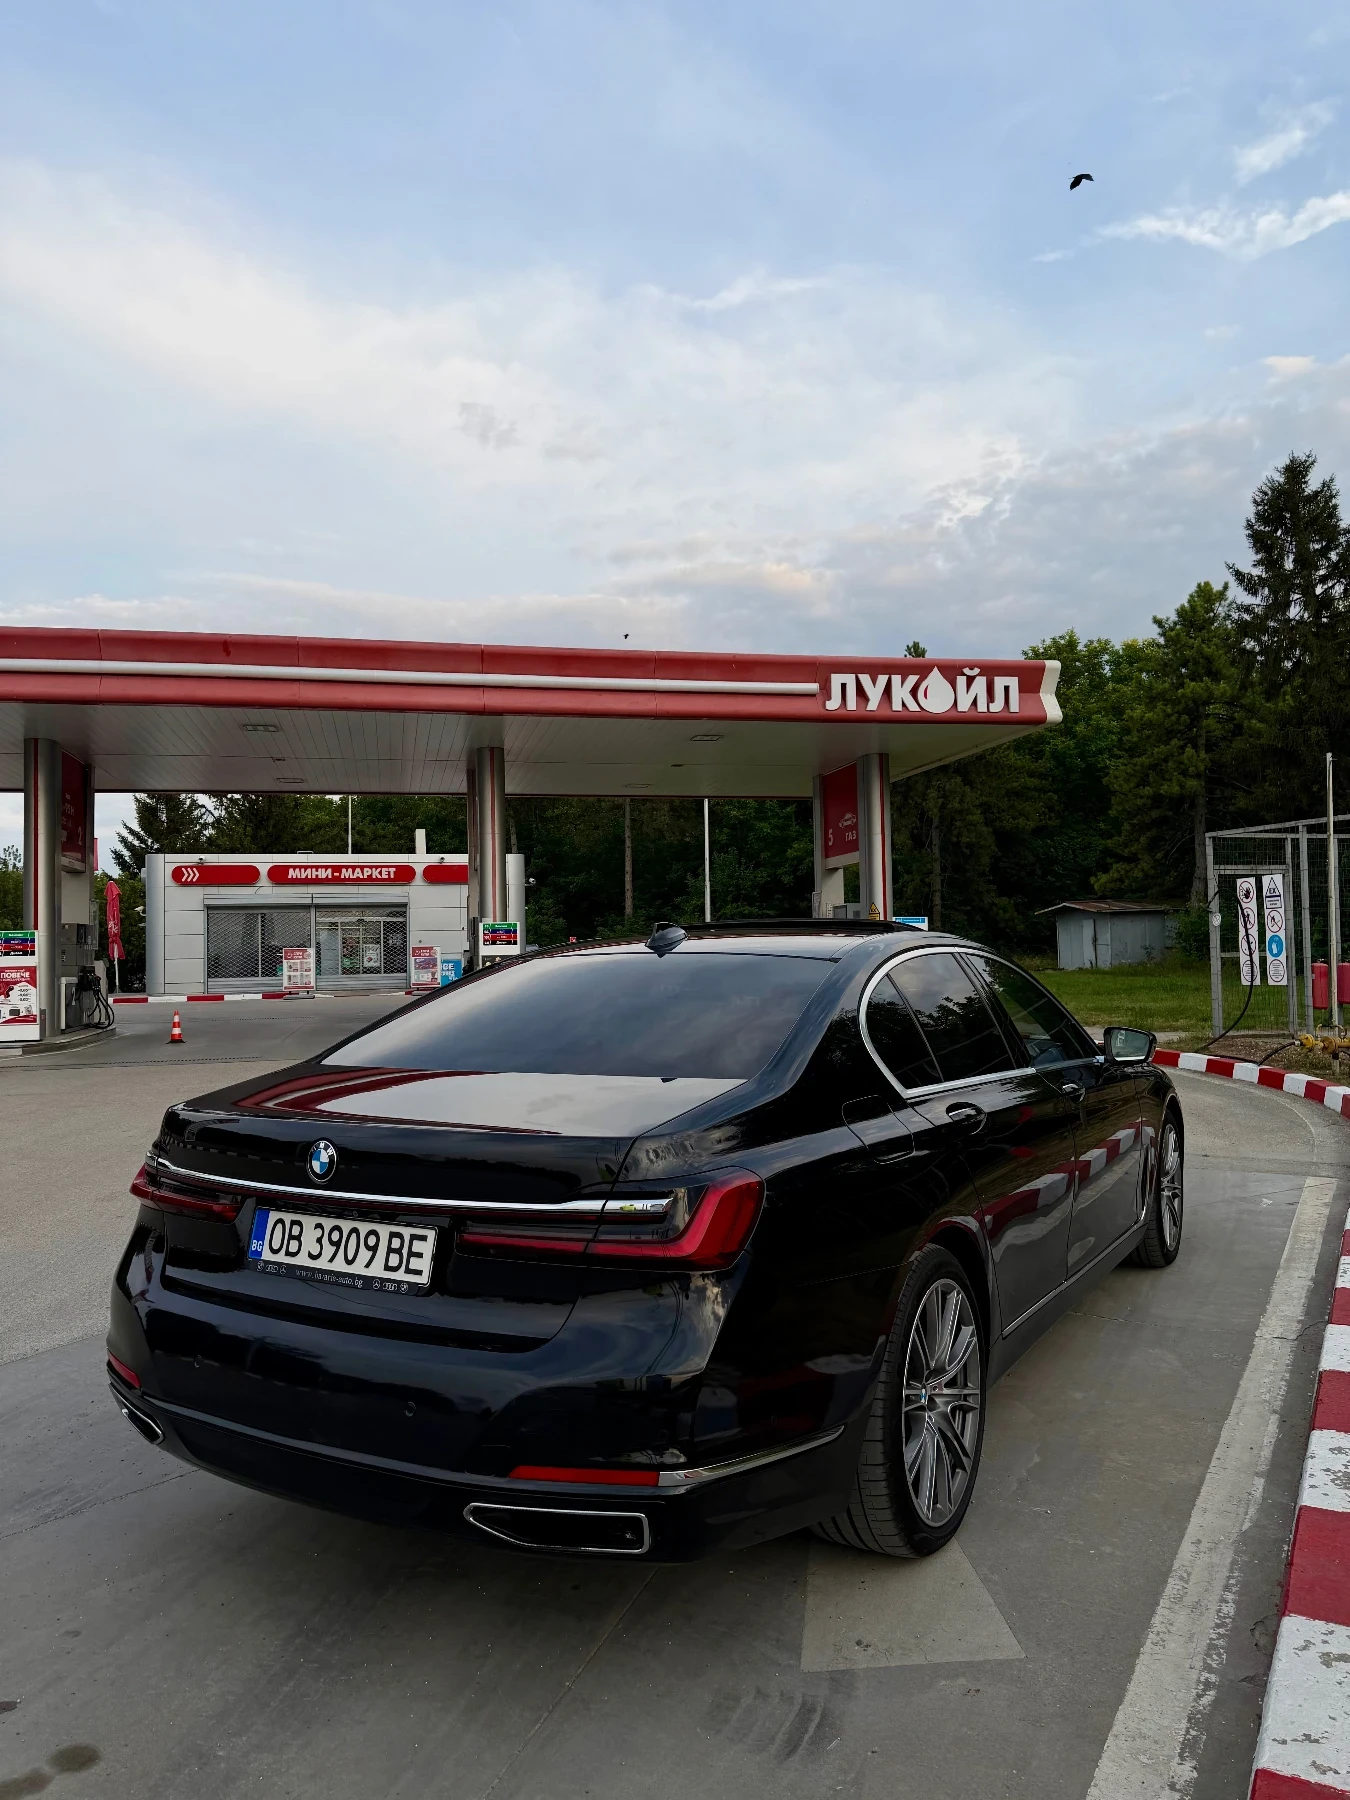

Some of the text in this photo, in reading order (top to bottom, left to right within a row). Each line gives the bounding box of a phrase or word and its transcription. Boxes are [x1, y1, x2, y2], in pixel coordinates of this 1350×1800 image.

[828, 829, 833, 846] 5
[845, 830, 857, 841] ГАЗ
[251, 1240, 263, 1251] BG
